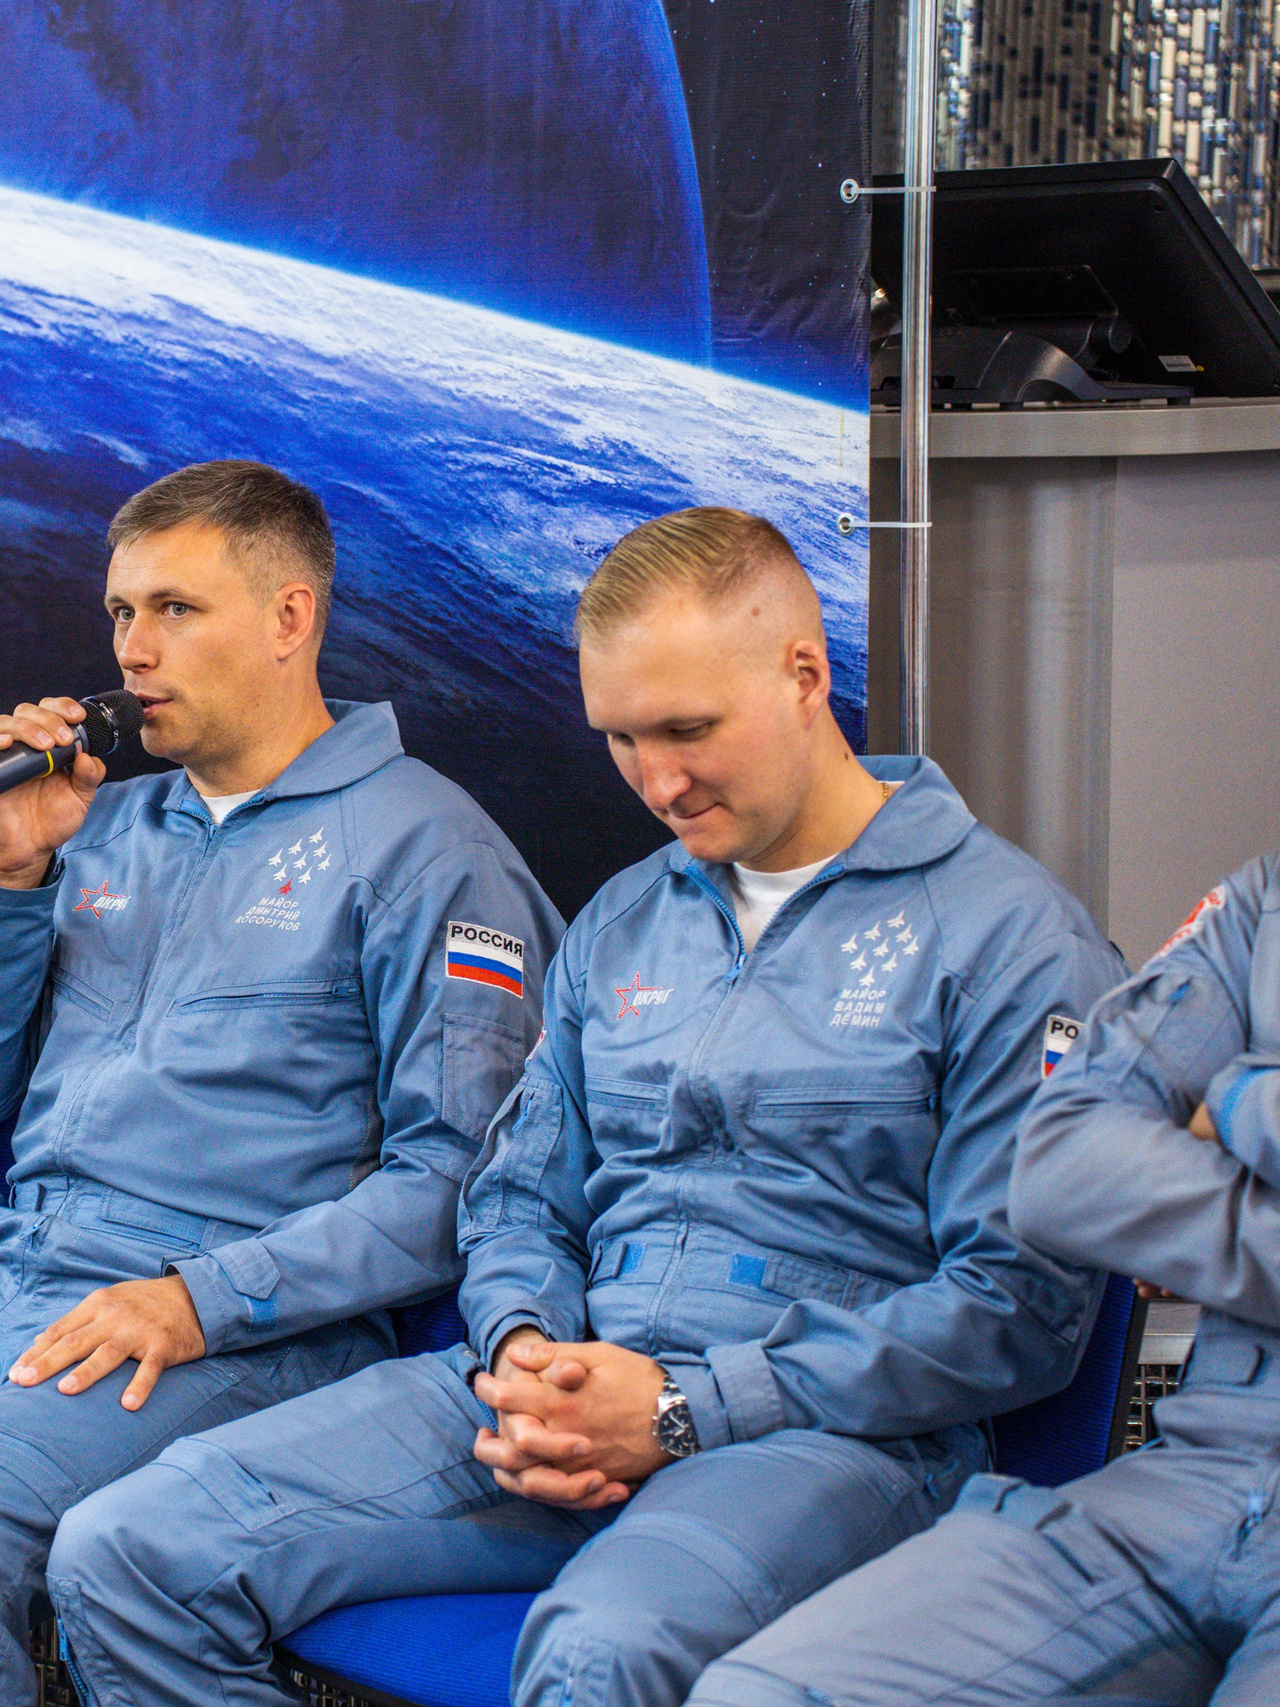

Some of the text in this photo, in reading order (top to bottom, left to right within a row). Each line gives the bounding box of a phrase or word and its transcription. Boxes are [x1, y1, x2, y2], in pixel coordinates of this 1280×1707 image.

[258, 897, 299, 909] МАЙОР
[246, 905, 300, 921] ДМИТРИЙ
[235, 916, 300, 931] КОСОРУКОВ
[451, 925, 523, 957] РОССИЯ
[633, 988, 674, 1006] ОКРУГ
[841, 988, 887, 1000] МАЙОР
[834, 1001, 885, 1014] ВАДИМ
